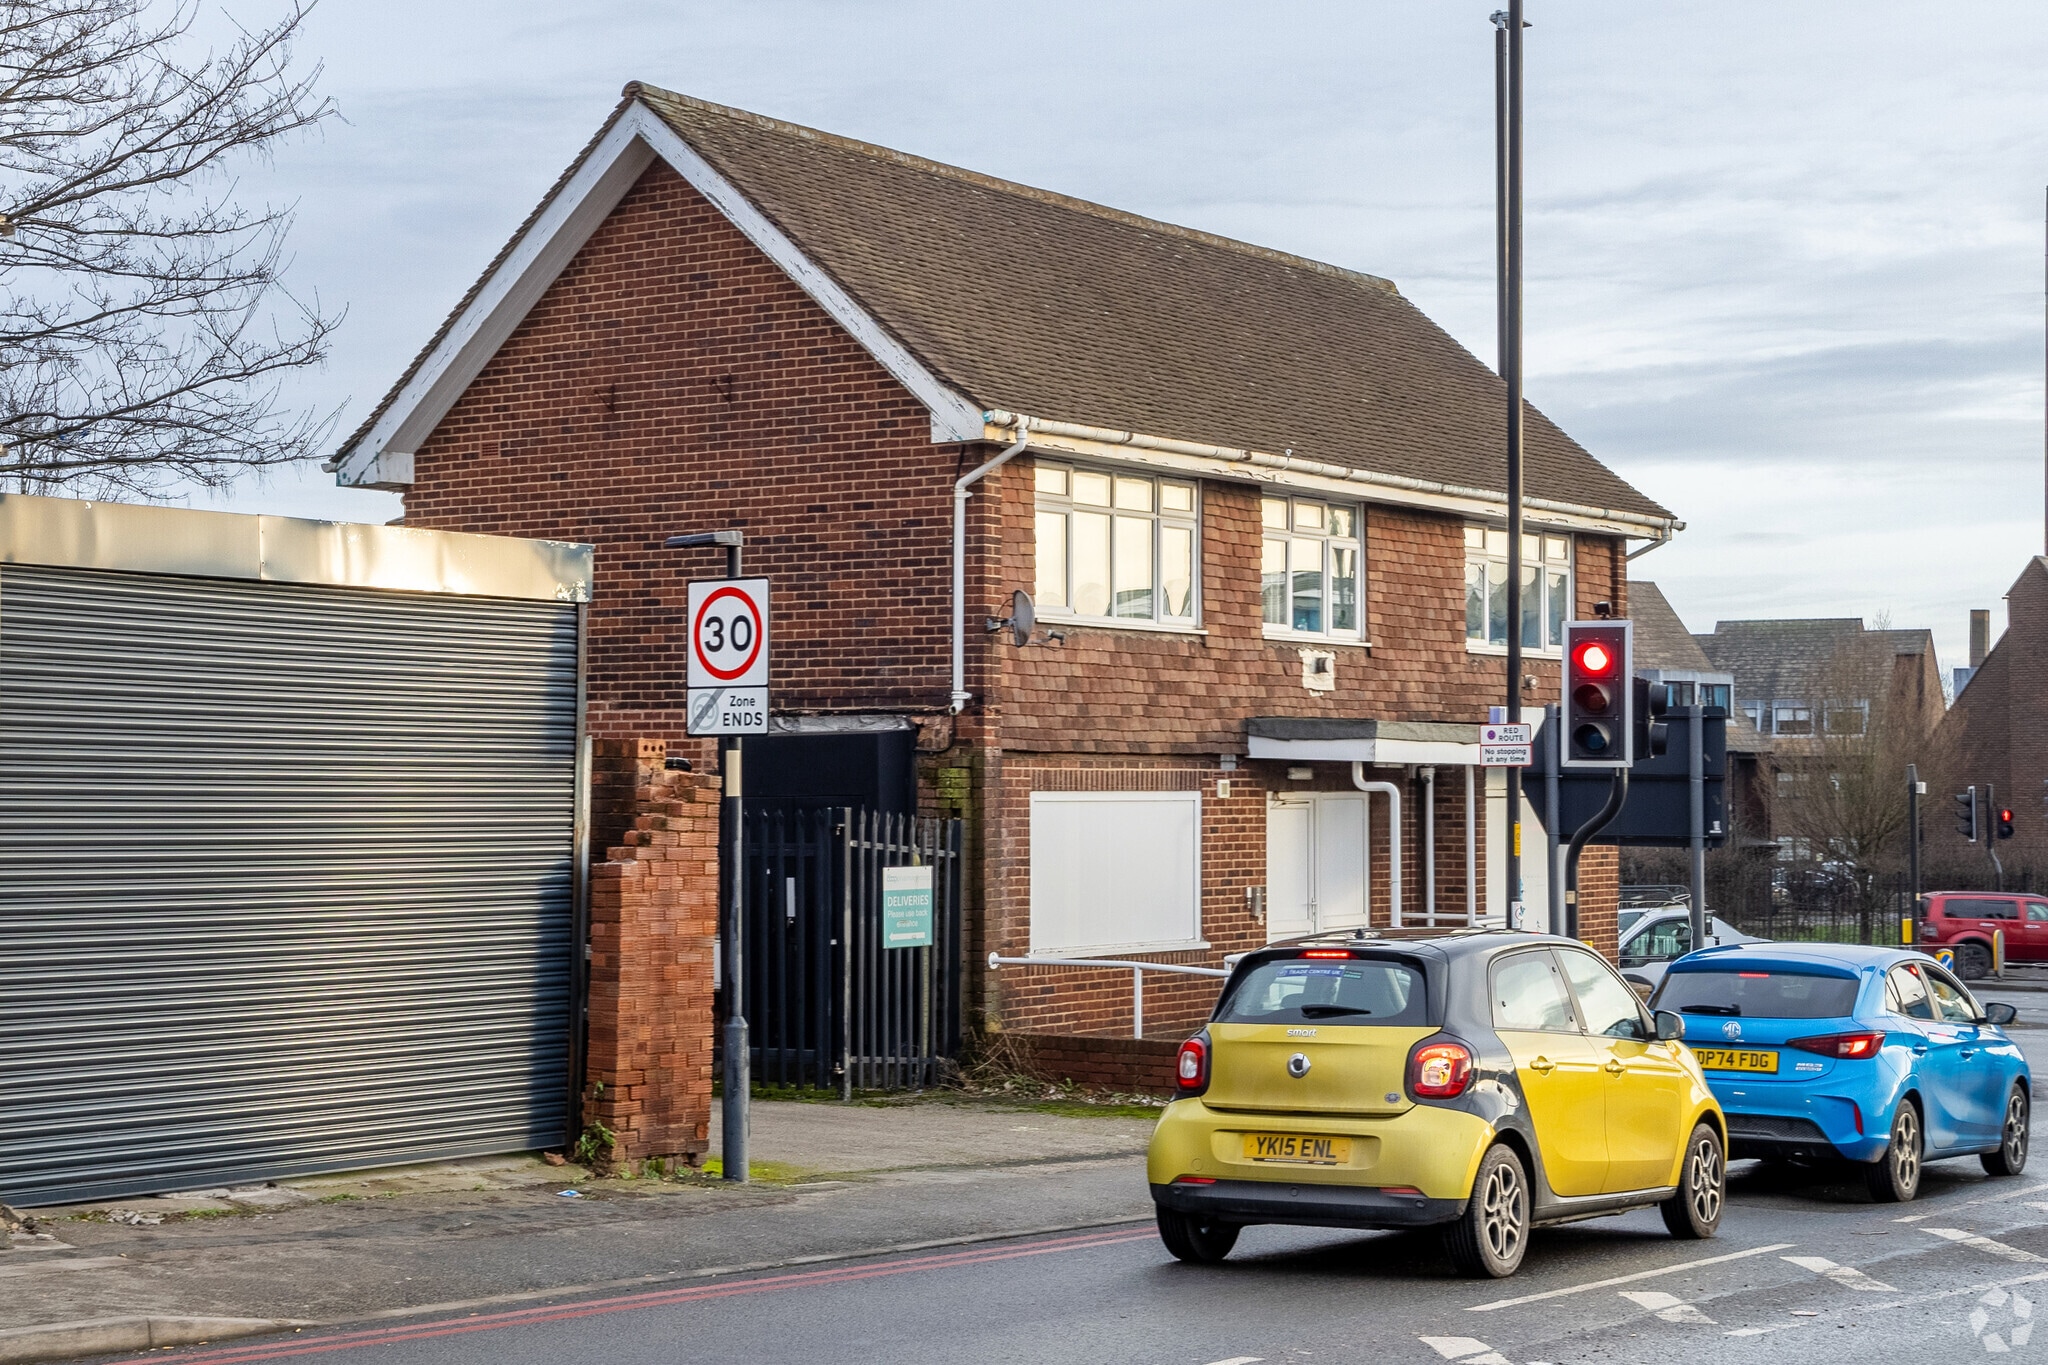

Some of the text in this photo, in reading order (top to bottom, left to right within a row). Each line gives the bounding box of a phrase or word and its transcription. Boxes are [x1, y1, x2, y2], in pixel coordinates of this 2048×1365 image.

[704, 615, 752, 652] 30
[729, 695, 756, 707] Zone
[723, 711, 763, 727] ENDS
[887, 894, 929, 907] DELIVERIES
[915, 909, 928, 917] back
[1287, 1028, 1317, 1037] smart
[1723, 1022, 1740, 1038] MG
[1697, 1050, 1769, 1068] DP74 FDG
[1256, 1136, 1337, 1158] YK15 ENL
